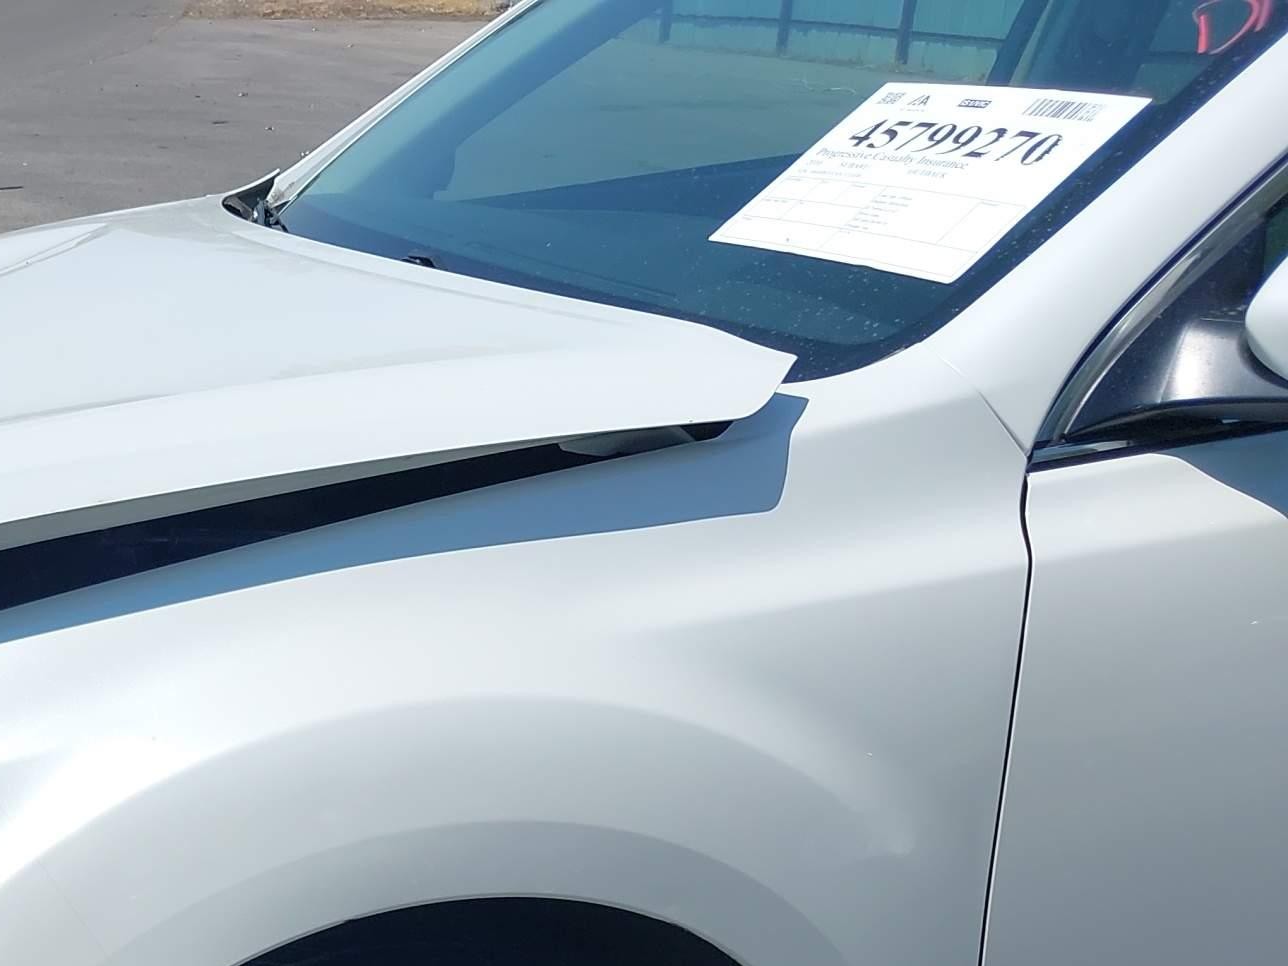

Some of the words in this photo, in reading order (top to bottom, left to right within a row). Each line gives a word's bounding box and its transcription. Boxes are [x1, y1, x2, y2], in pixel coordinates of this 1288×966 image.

[816, 147, 872, 160] Progressive
[873, 152, 914, 166] Casualty
[917, 156, 969, 170] Insurance
[848, 119, 1063, 165] 45799270
